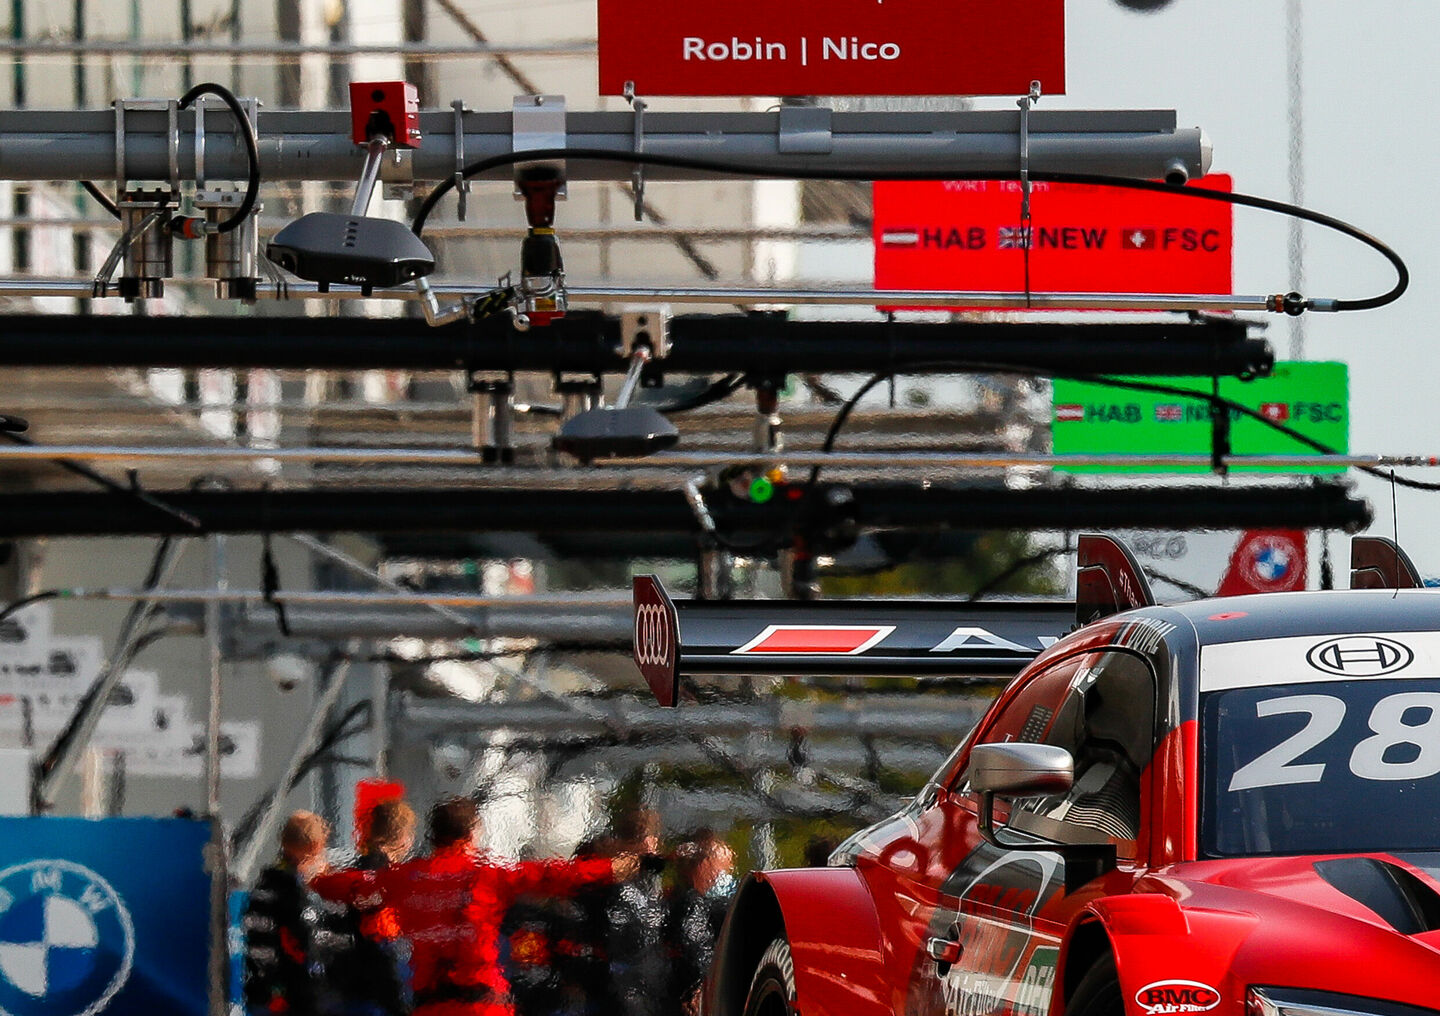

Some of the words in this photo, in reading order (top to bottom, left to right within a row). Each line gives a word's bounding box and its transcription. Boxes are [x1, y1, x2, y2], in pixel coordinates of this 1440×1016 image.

[682, 36, 787, 61] Robin
[822, 36, 901, 61] Nico
[923, 227, 987, 250] HAB
[1039, 227, 1108, 250] NEW
[1163, 228, 1221, 252] FSC
[1087, 403, 1143, 424] HAB
[1293, 402, 1344, 424] FSC
[1145, 988, 1213, 1005] BMC
[1145, 1003, 1180, 1015] Air
